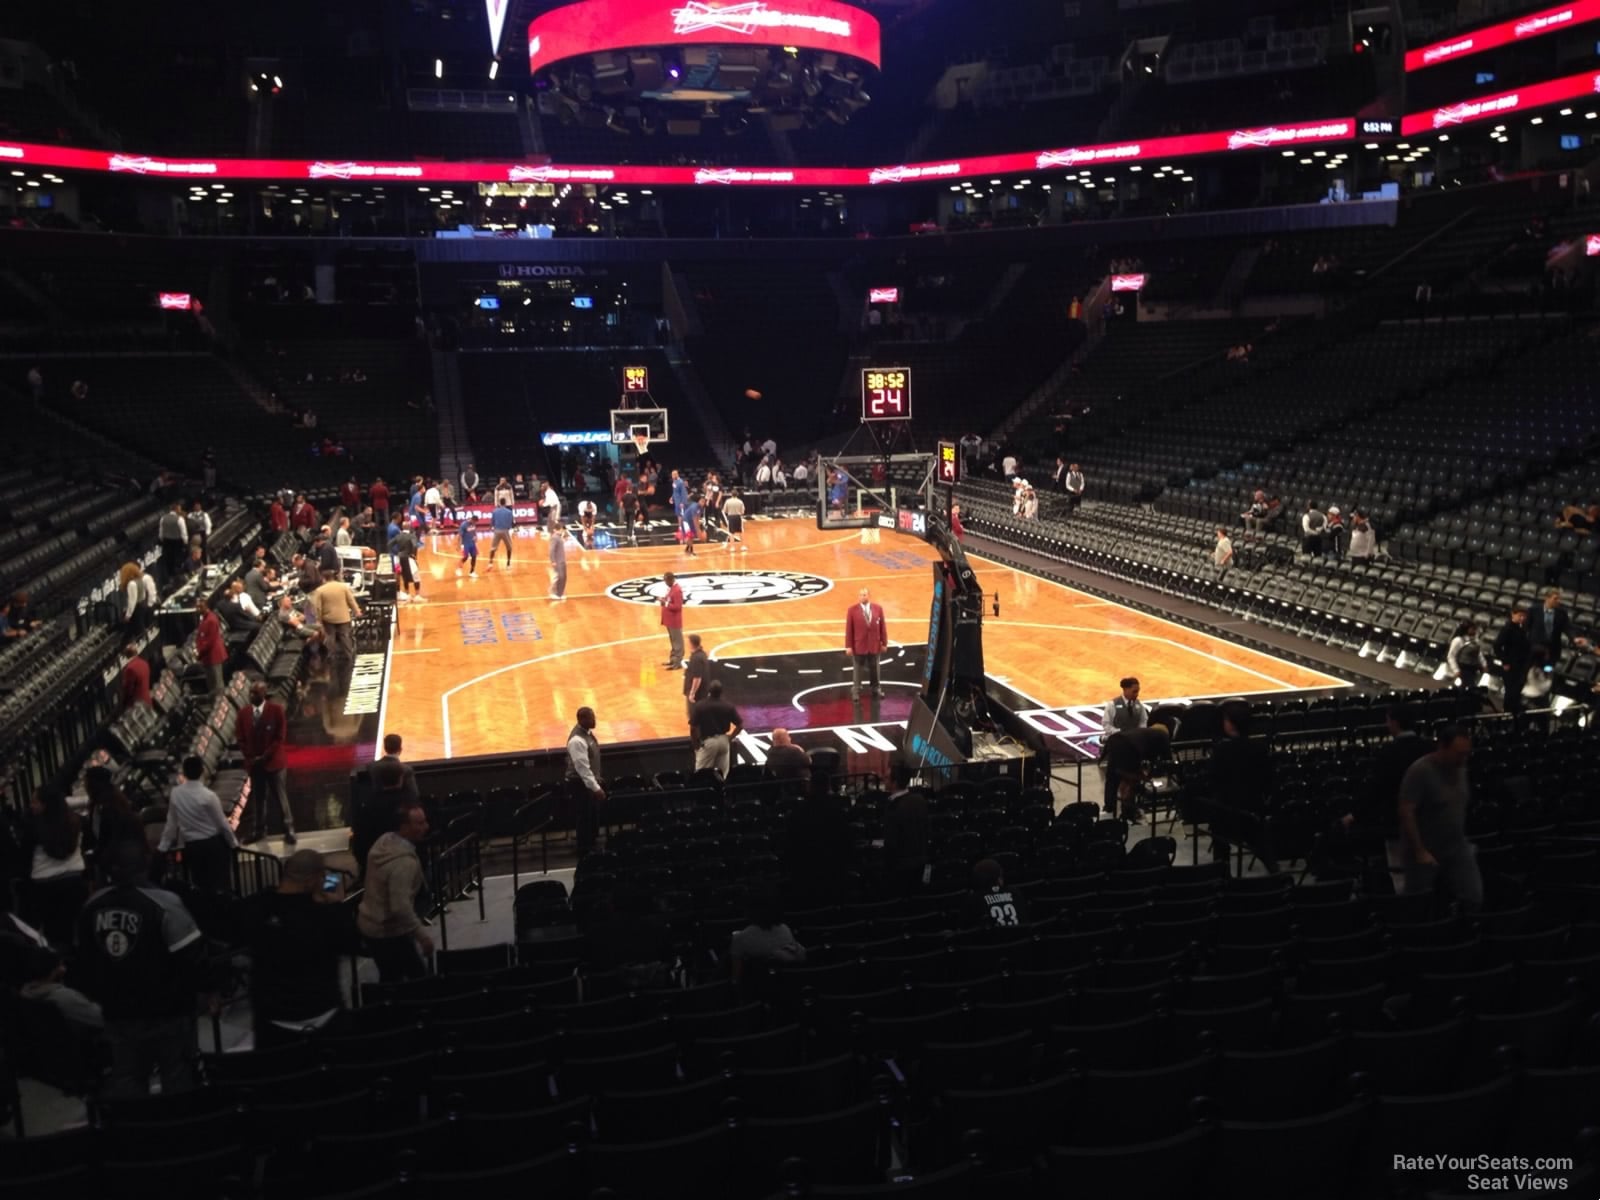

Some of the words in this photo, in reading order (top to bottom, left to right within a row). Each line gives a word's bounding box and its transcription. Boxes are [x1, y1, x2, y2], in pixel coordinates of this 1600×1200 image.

[517, 265, 585, 276] HONDA
[628, 377, 643, 389] 24
[868, 373, 904, 389] 38:52
[872, 389, 901, 414] 24
[95, 911, 138, 934] NETS
